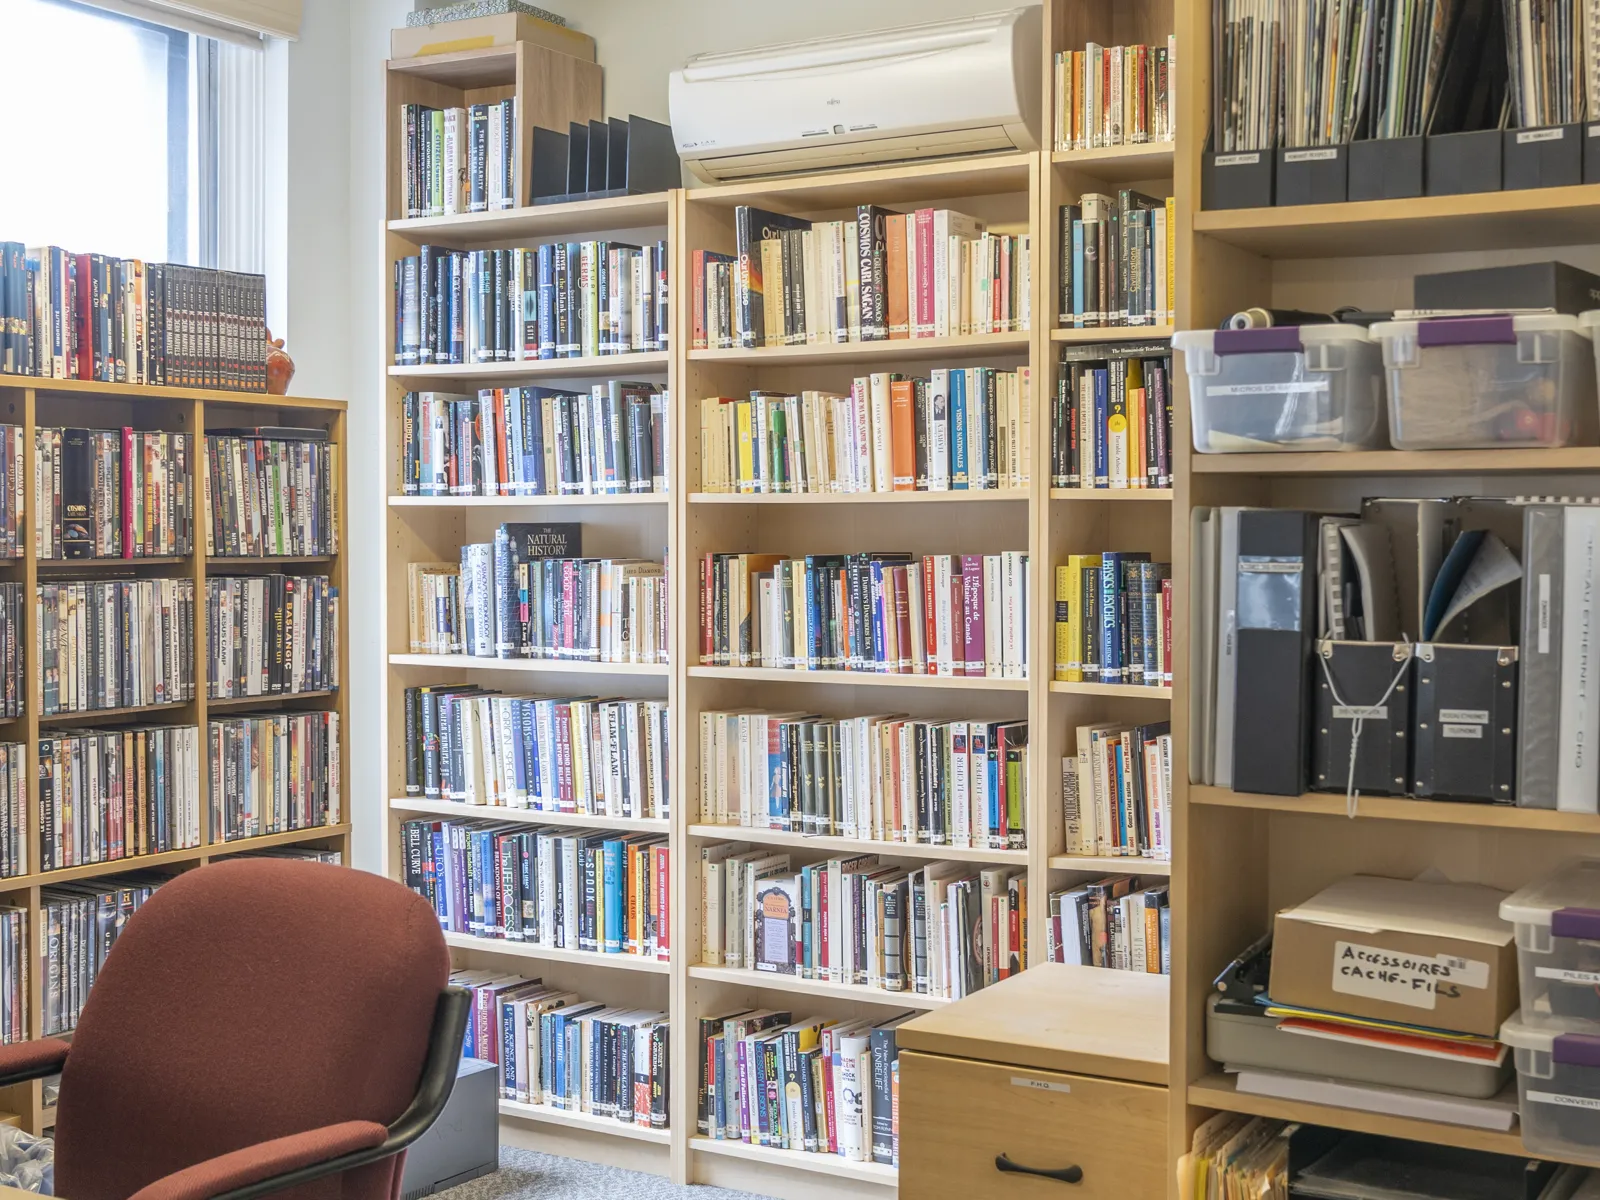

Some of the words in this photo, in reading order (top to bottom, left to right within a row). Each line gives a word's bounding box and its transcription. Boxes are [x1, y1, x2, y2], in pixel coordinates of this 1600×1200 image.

[527, 534, 568, 544] NATURAL
[528, 545, 567, 556] HISTORY
[411, 829, 420, 847] BELL
[412, 848, 420, 874] CURVE
[586, 863, 594, 901] SPOOK
[874, 1047, 882, 1090] UNBELIEF
